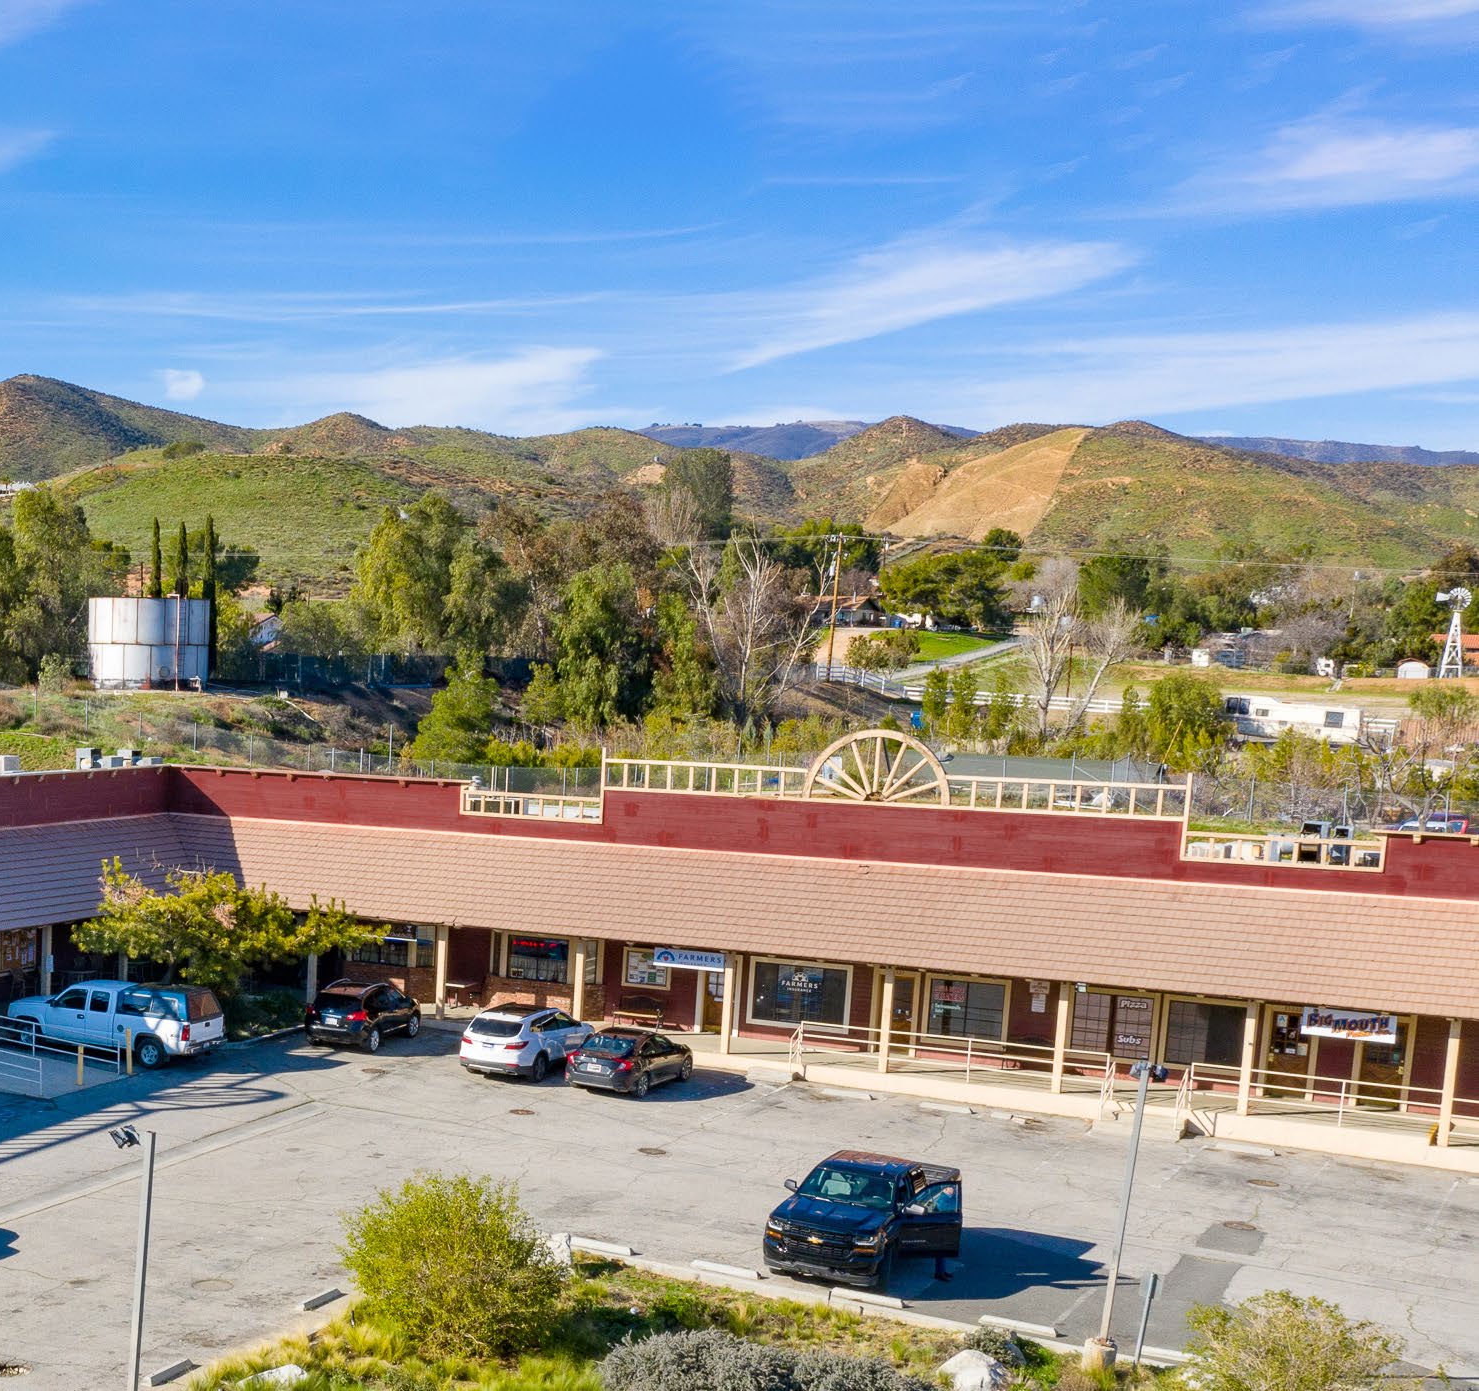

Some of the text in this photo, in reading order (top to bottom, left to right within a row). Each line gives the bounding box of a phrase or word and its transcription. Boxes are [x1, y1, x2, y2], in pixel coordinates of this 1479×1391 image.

[678, 953, 722, 964] FARMERS
[781, 980, 818, 989] FARMERS
[1120, 1000, 1147, 1009] Pizza
[1307, 1013, 1333, 1028] BIG
[1332, 1016, 1391, 1033] MOUTH
[1117, 1034, 1142, 1045] Subs
